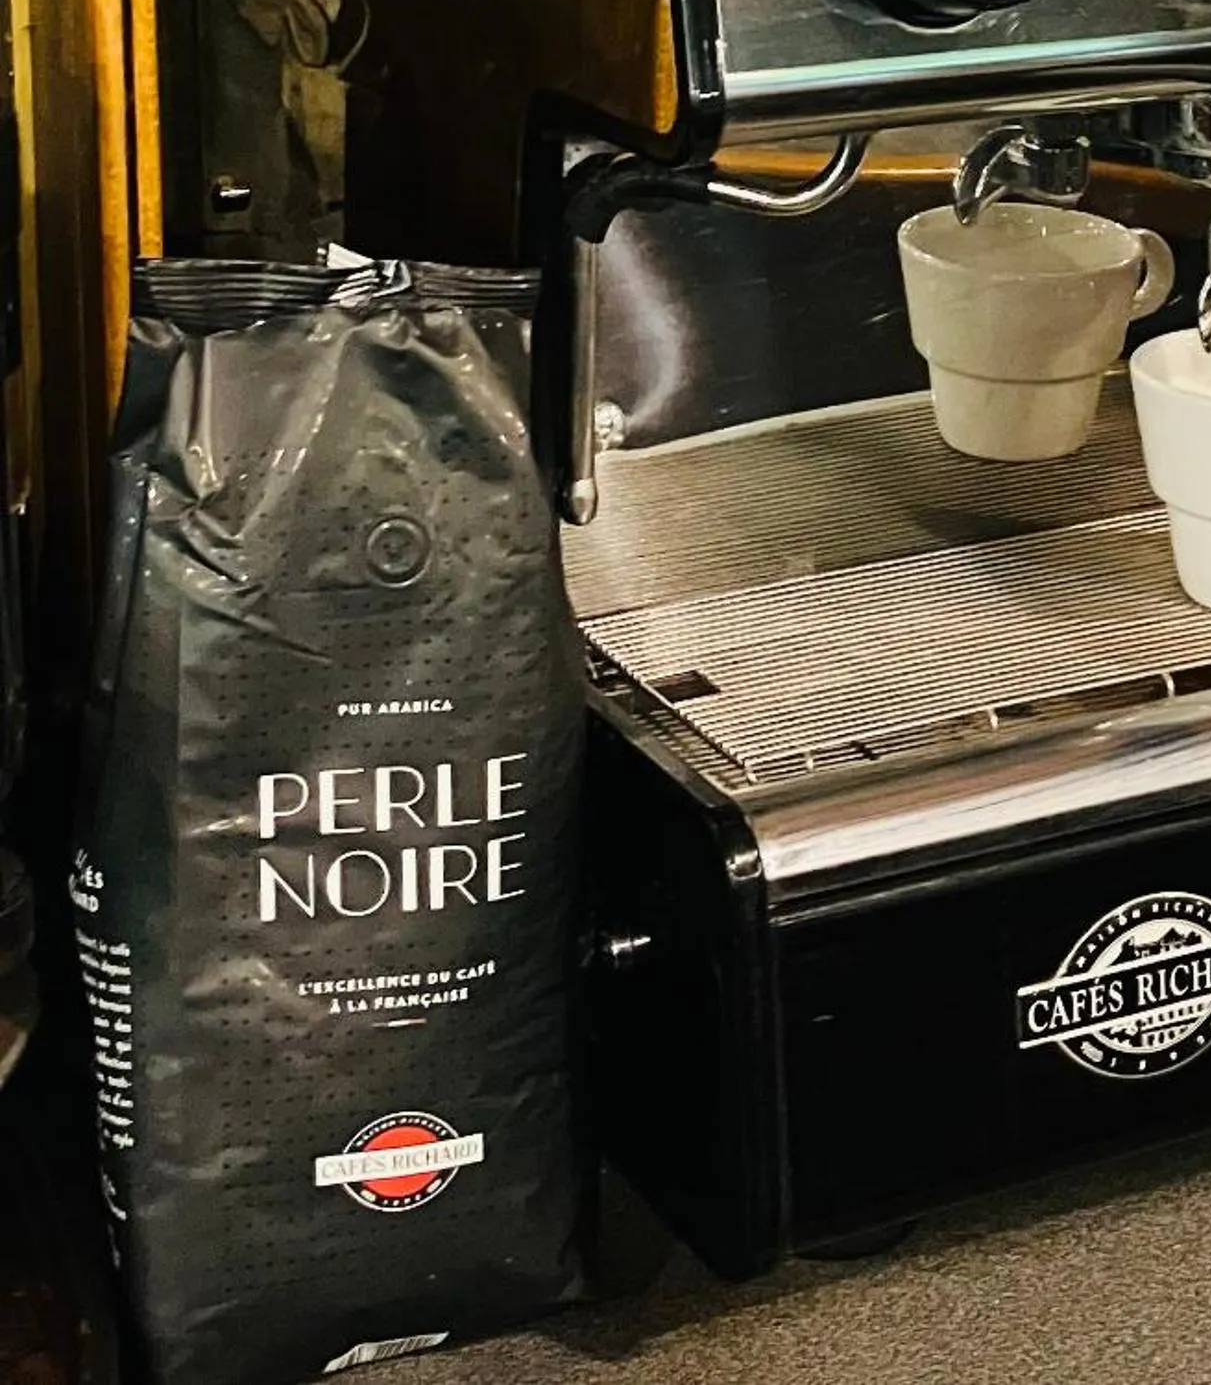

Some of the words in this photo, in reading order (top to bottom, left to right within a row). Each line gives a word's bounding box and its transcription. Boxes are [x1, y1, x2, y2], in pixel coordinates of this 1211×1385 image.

[337, 702, 372, 717] PUR
[377, 698, 455, 714] ARABICA
[258, 752, 528, 840] PERLE
[259, 832, 528, 923] NOIRE
[299, 974, 421, 996] L'EXCELLENCE
[427, 970, 451, 985] DU
[456, 960, 496, 981] CAFÉ
[346, 1000, 369, 1013] LA
[374, 987, 469, 1010] FRANÇAISE
[1027, 977, 1125, 1034] CAFÉS
[321, 1155, 386, 1180] CAFÉS
[392, 1139, 479, 1172] RICHARD
